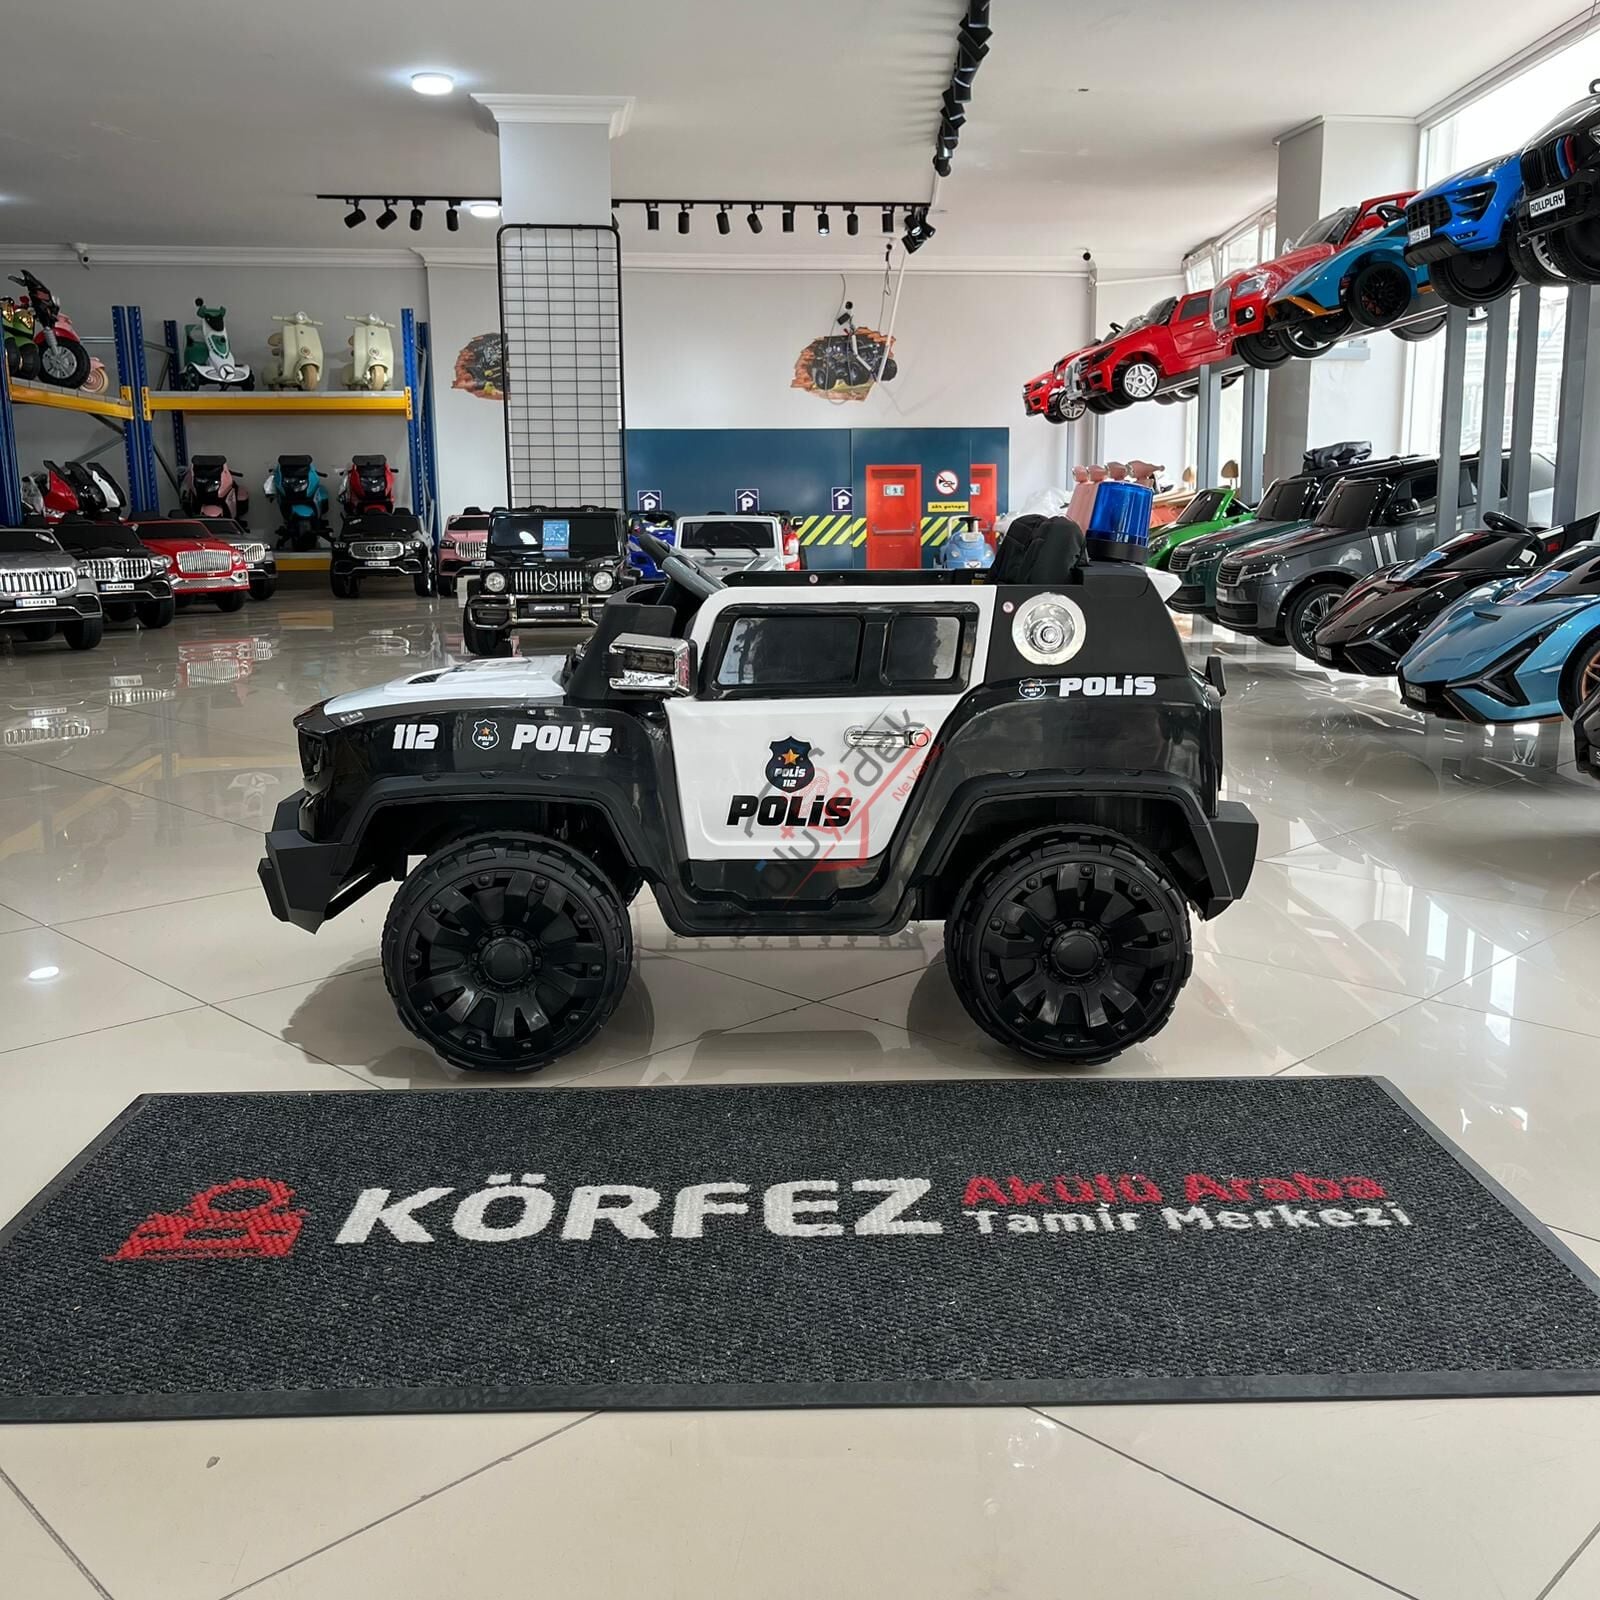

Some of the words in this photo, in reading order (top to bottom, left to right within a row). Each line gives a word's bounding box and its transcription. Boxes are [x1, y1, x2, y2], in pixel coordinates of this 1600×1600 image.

[837, 496, 849, 510] P
[392, 723, 439, 750] 112
[782, 779, 798, 788] 112
[1183, 1171, 1386, 1204] Araba
[335, 1172, 942, 1245] KÖRFEZ
[962, 1204, 1141, 1236] Tamir
[1160, 1202, 1414, 1232] Merkezi
